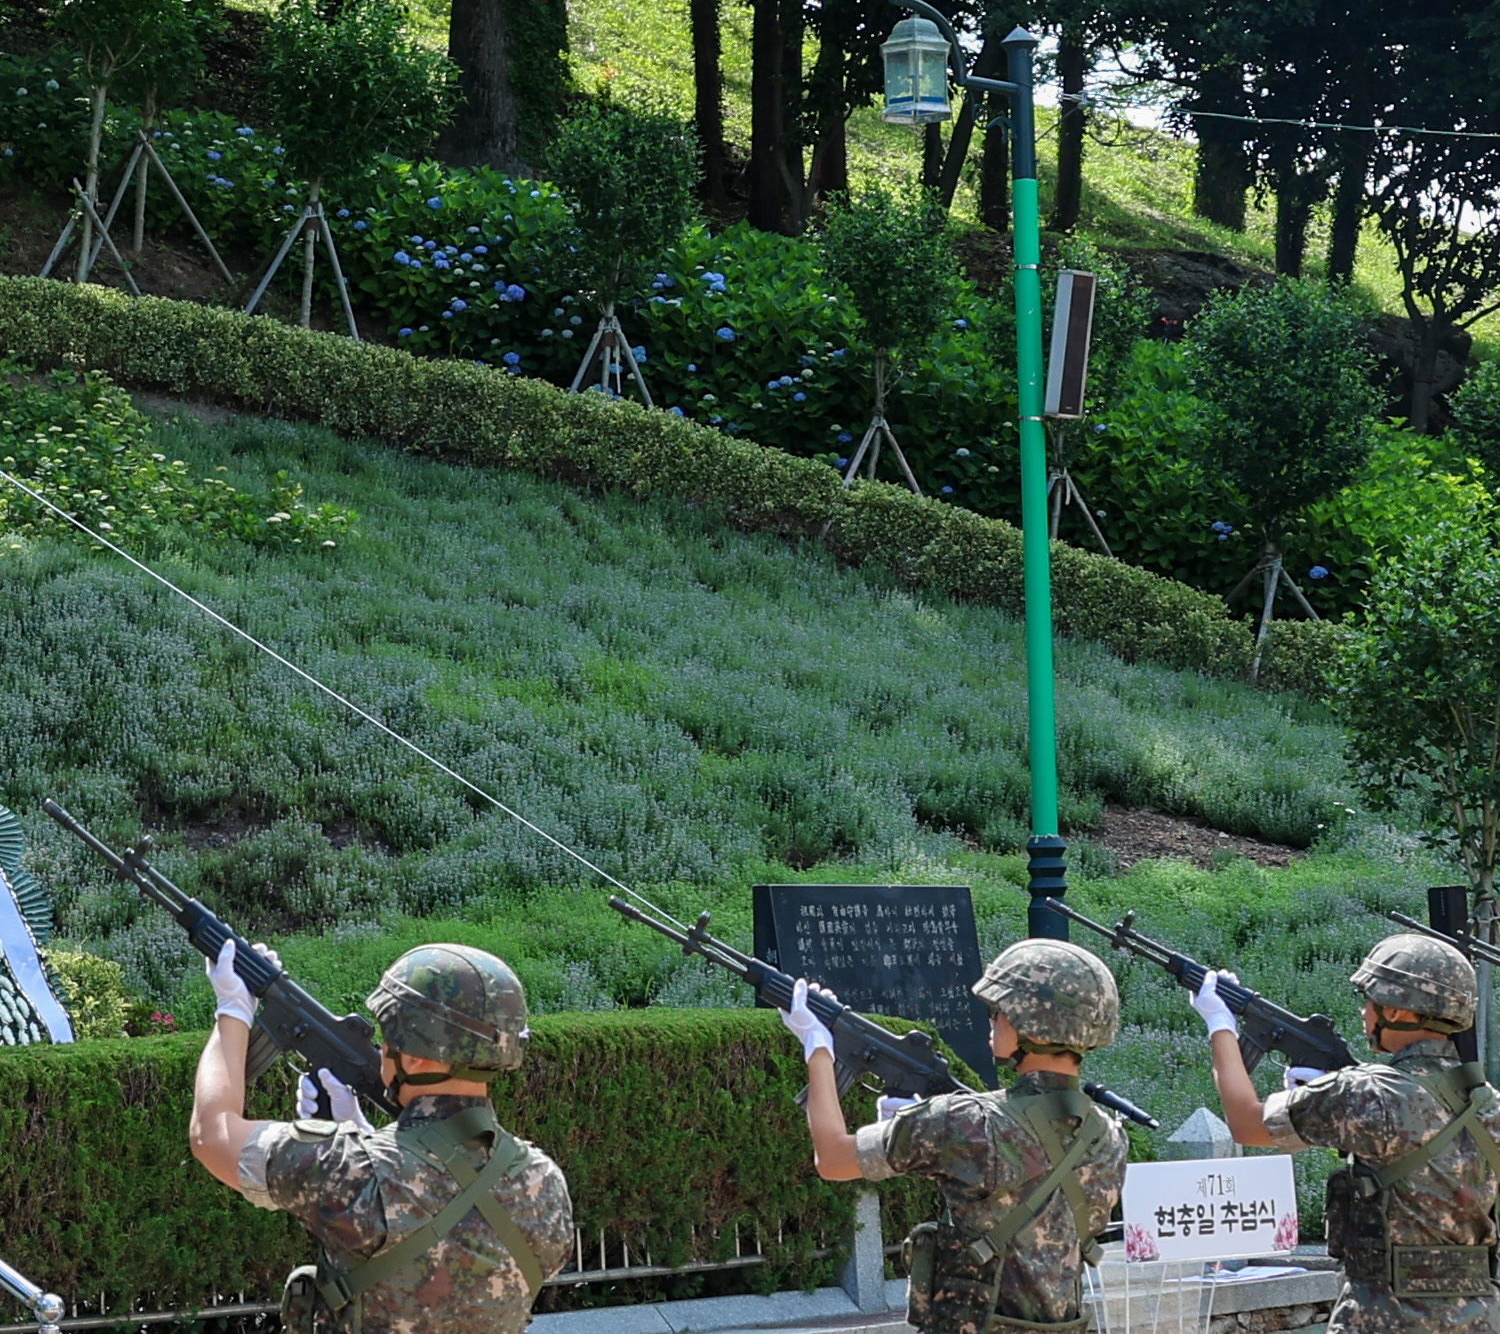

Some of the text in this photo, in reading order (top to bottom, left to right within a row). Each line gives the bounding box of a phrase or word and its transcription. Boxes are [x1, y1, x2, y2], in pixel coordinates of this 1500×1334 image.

[1196, 1174, 1236, 1198] 제71회
[1154, 1199, 1276, 1238] 현충일 추념식
